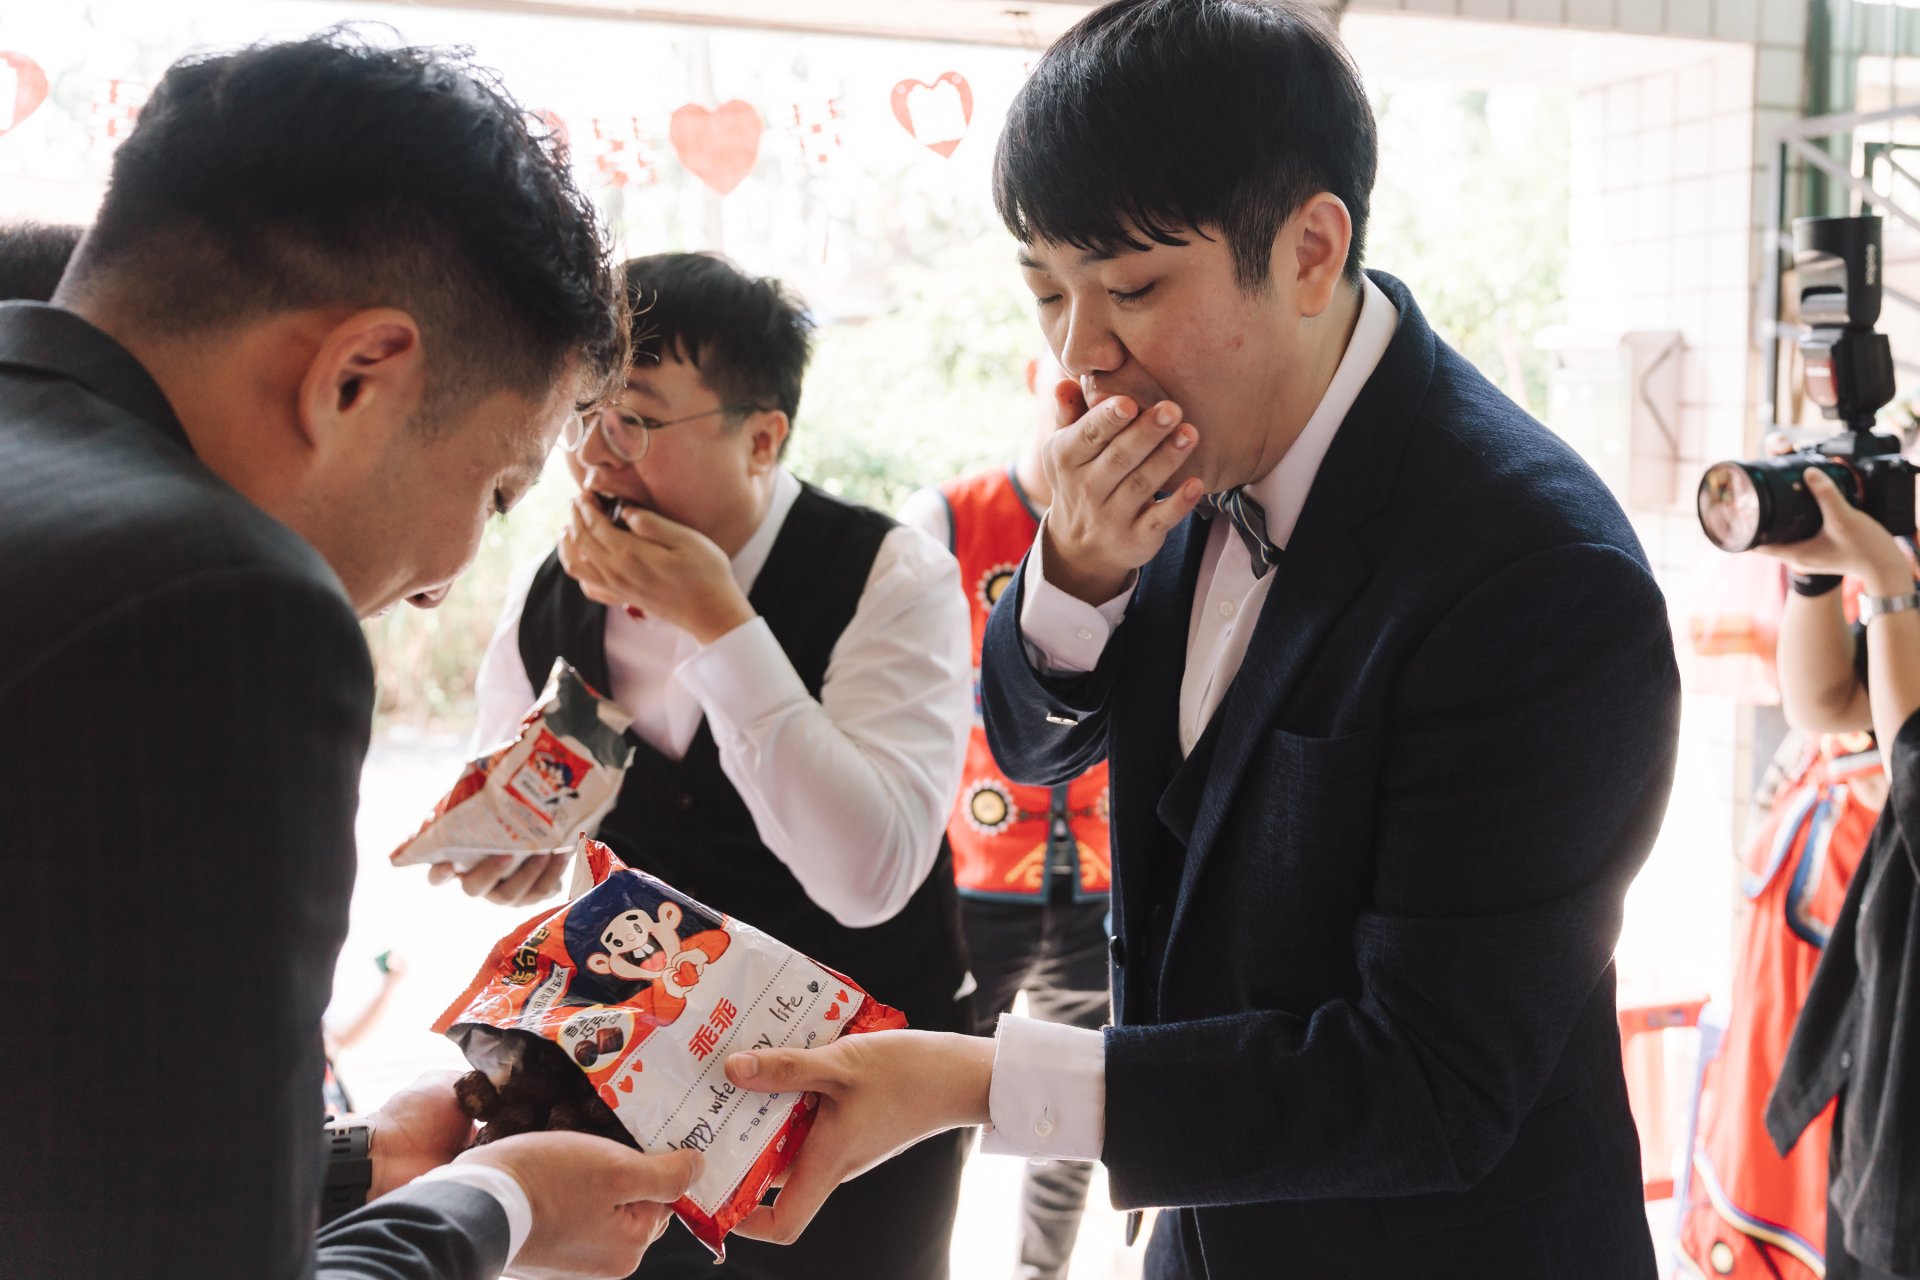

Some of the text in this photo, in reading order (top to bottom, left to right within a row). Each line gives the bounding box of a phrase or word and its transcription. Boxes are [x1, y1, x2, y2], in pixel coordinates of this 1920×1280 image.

[769, 995, 804, 1023] life
[688, 997, 737, 1062] 乖乖
[708, 1082, 737, 1115] wife
